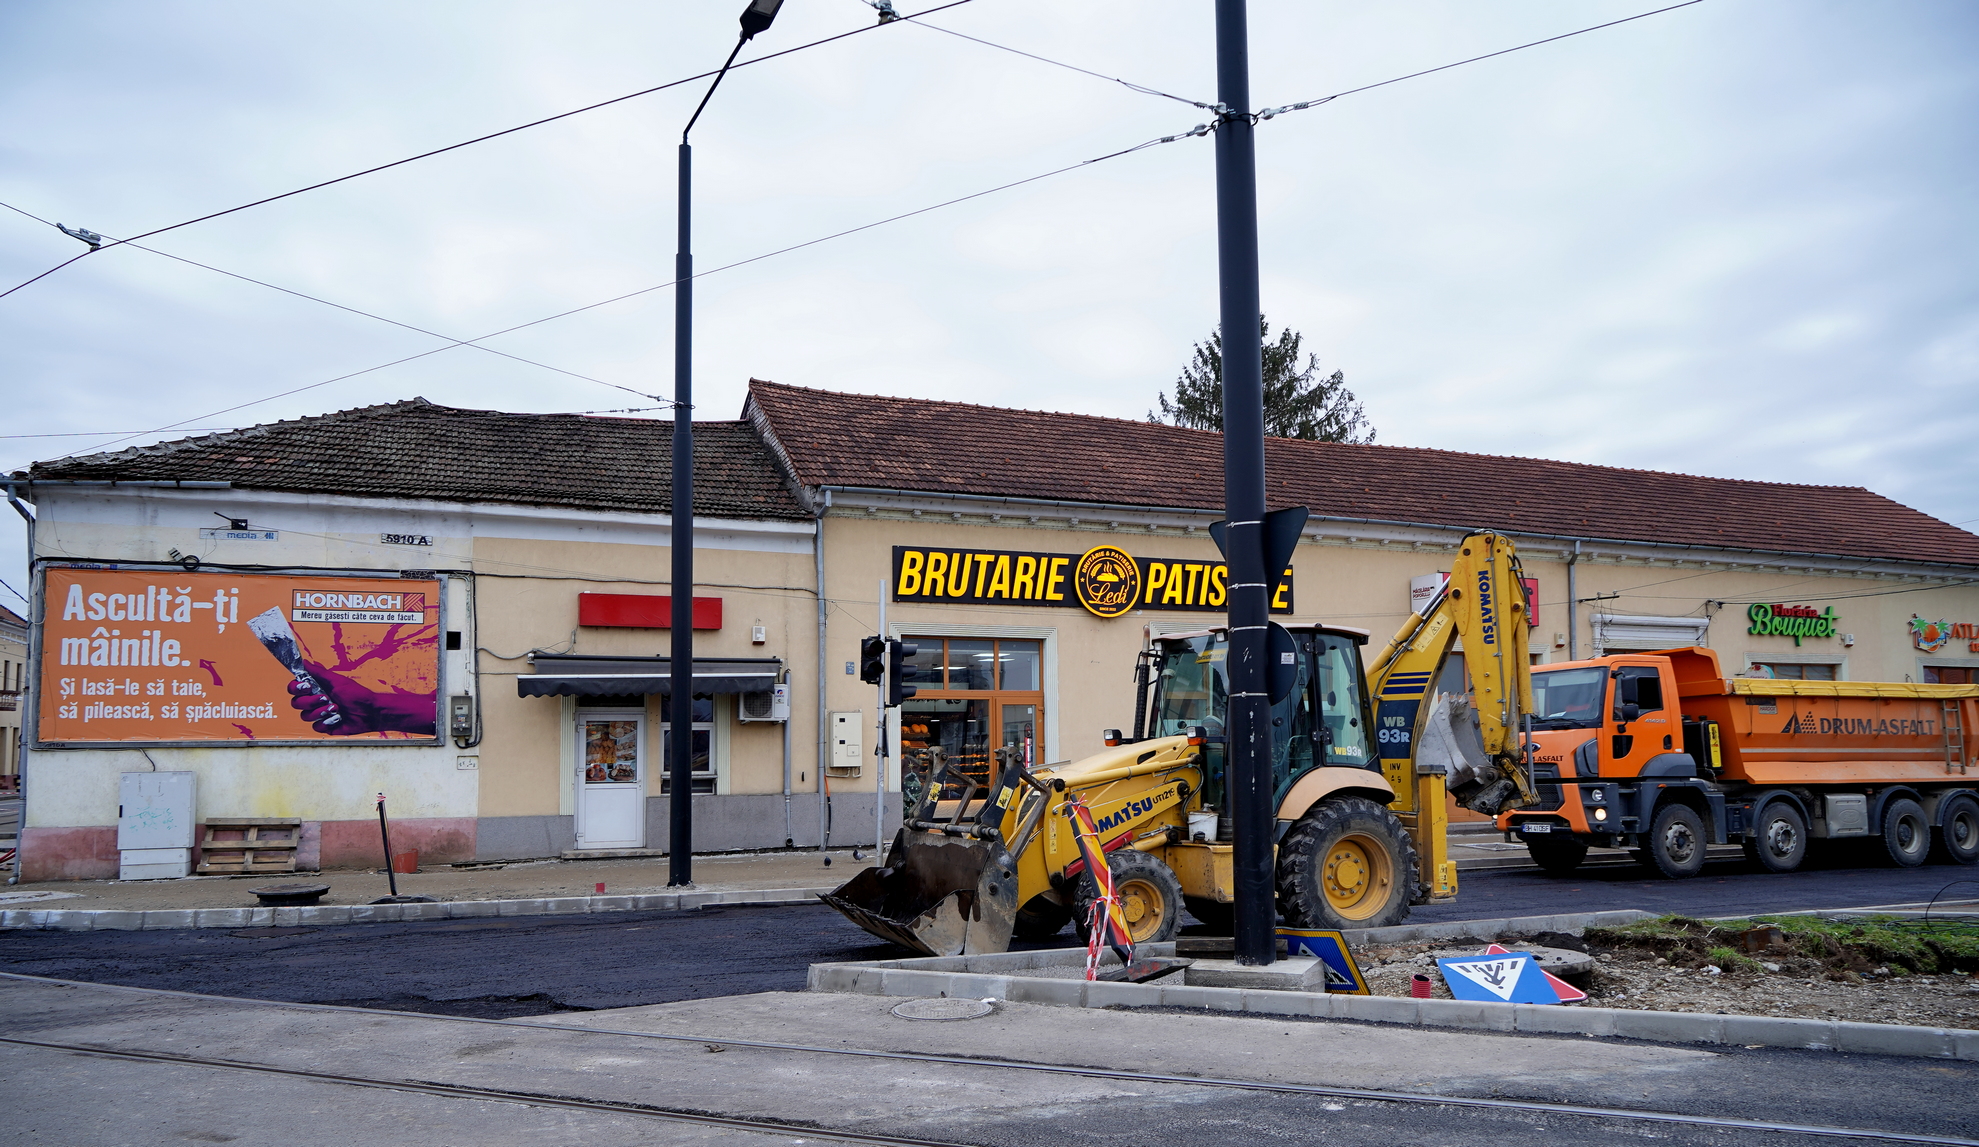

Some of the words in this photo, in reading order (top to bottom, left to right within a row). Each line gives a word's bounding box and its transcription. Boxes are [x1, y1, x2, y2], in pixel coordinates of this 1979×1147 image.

[386, 534, 414, 545] 5910
[418, 536, 428, 545] A
[1111, 551, 1135, 576] PATISERIE
[897, 550, 1070, 601] BRUTARIE
[1144, 562, 1292, 609] PATISE
[295, 592, 401, 609] HORNBACH
[1088, 582, 1128, 605] Ledi
[62, 583, 239, 634] Ascultă-ți
[301, 611, 322, 619] Mereu
[386, 613, 395, 621] de
[1478, 570, 1497, 644] KOMATSU
[1748, 603, 1842, 647] Bouquet
[60, 626, 191, 667] mâinile.
[60, 677, 75, 700] Și
[82, 678, 140, 696] lasă-le
[146, 679, 165, 696] să
[171, 679, 207, 698] taie,
[58, 702, 78, 719] să
[84, 701, 154, 723] pilească,
[161, 702, 179, 719] să
[1383, 716, 1406, 727] WB
[1378, 729, 1410, 743] 93R
[1819, 717, 1935, 735] DRUM-ASFALT
[1094, 797, 1153, 833] MATSU
